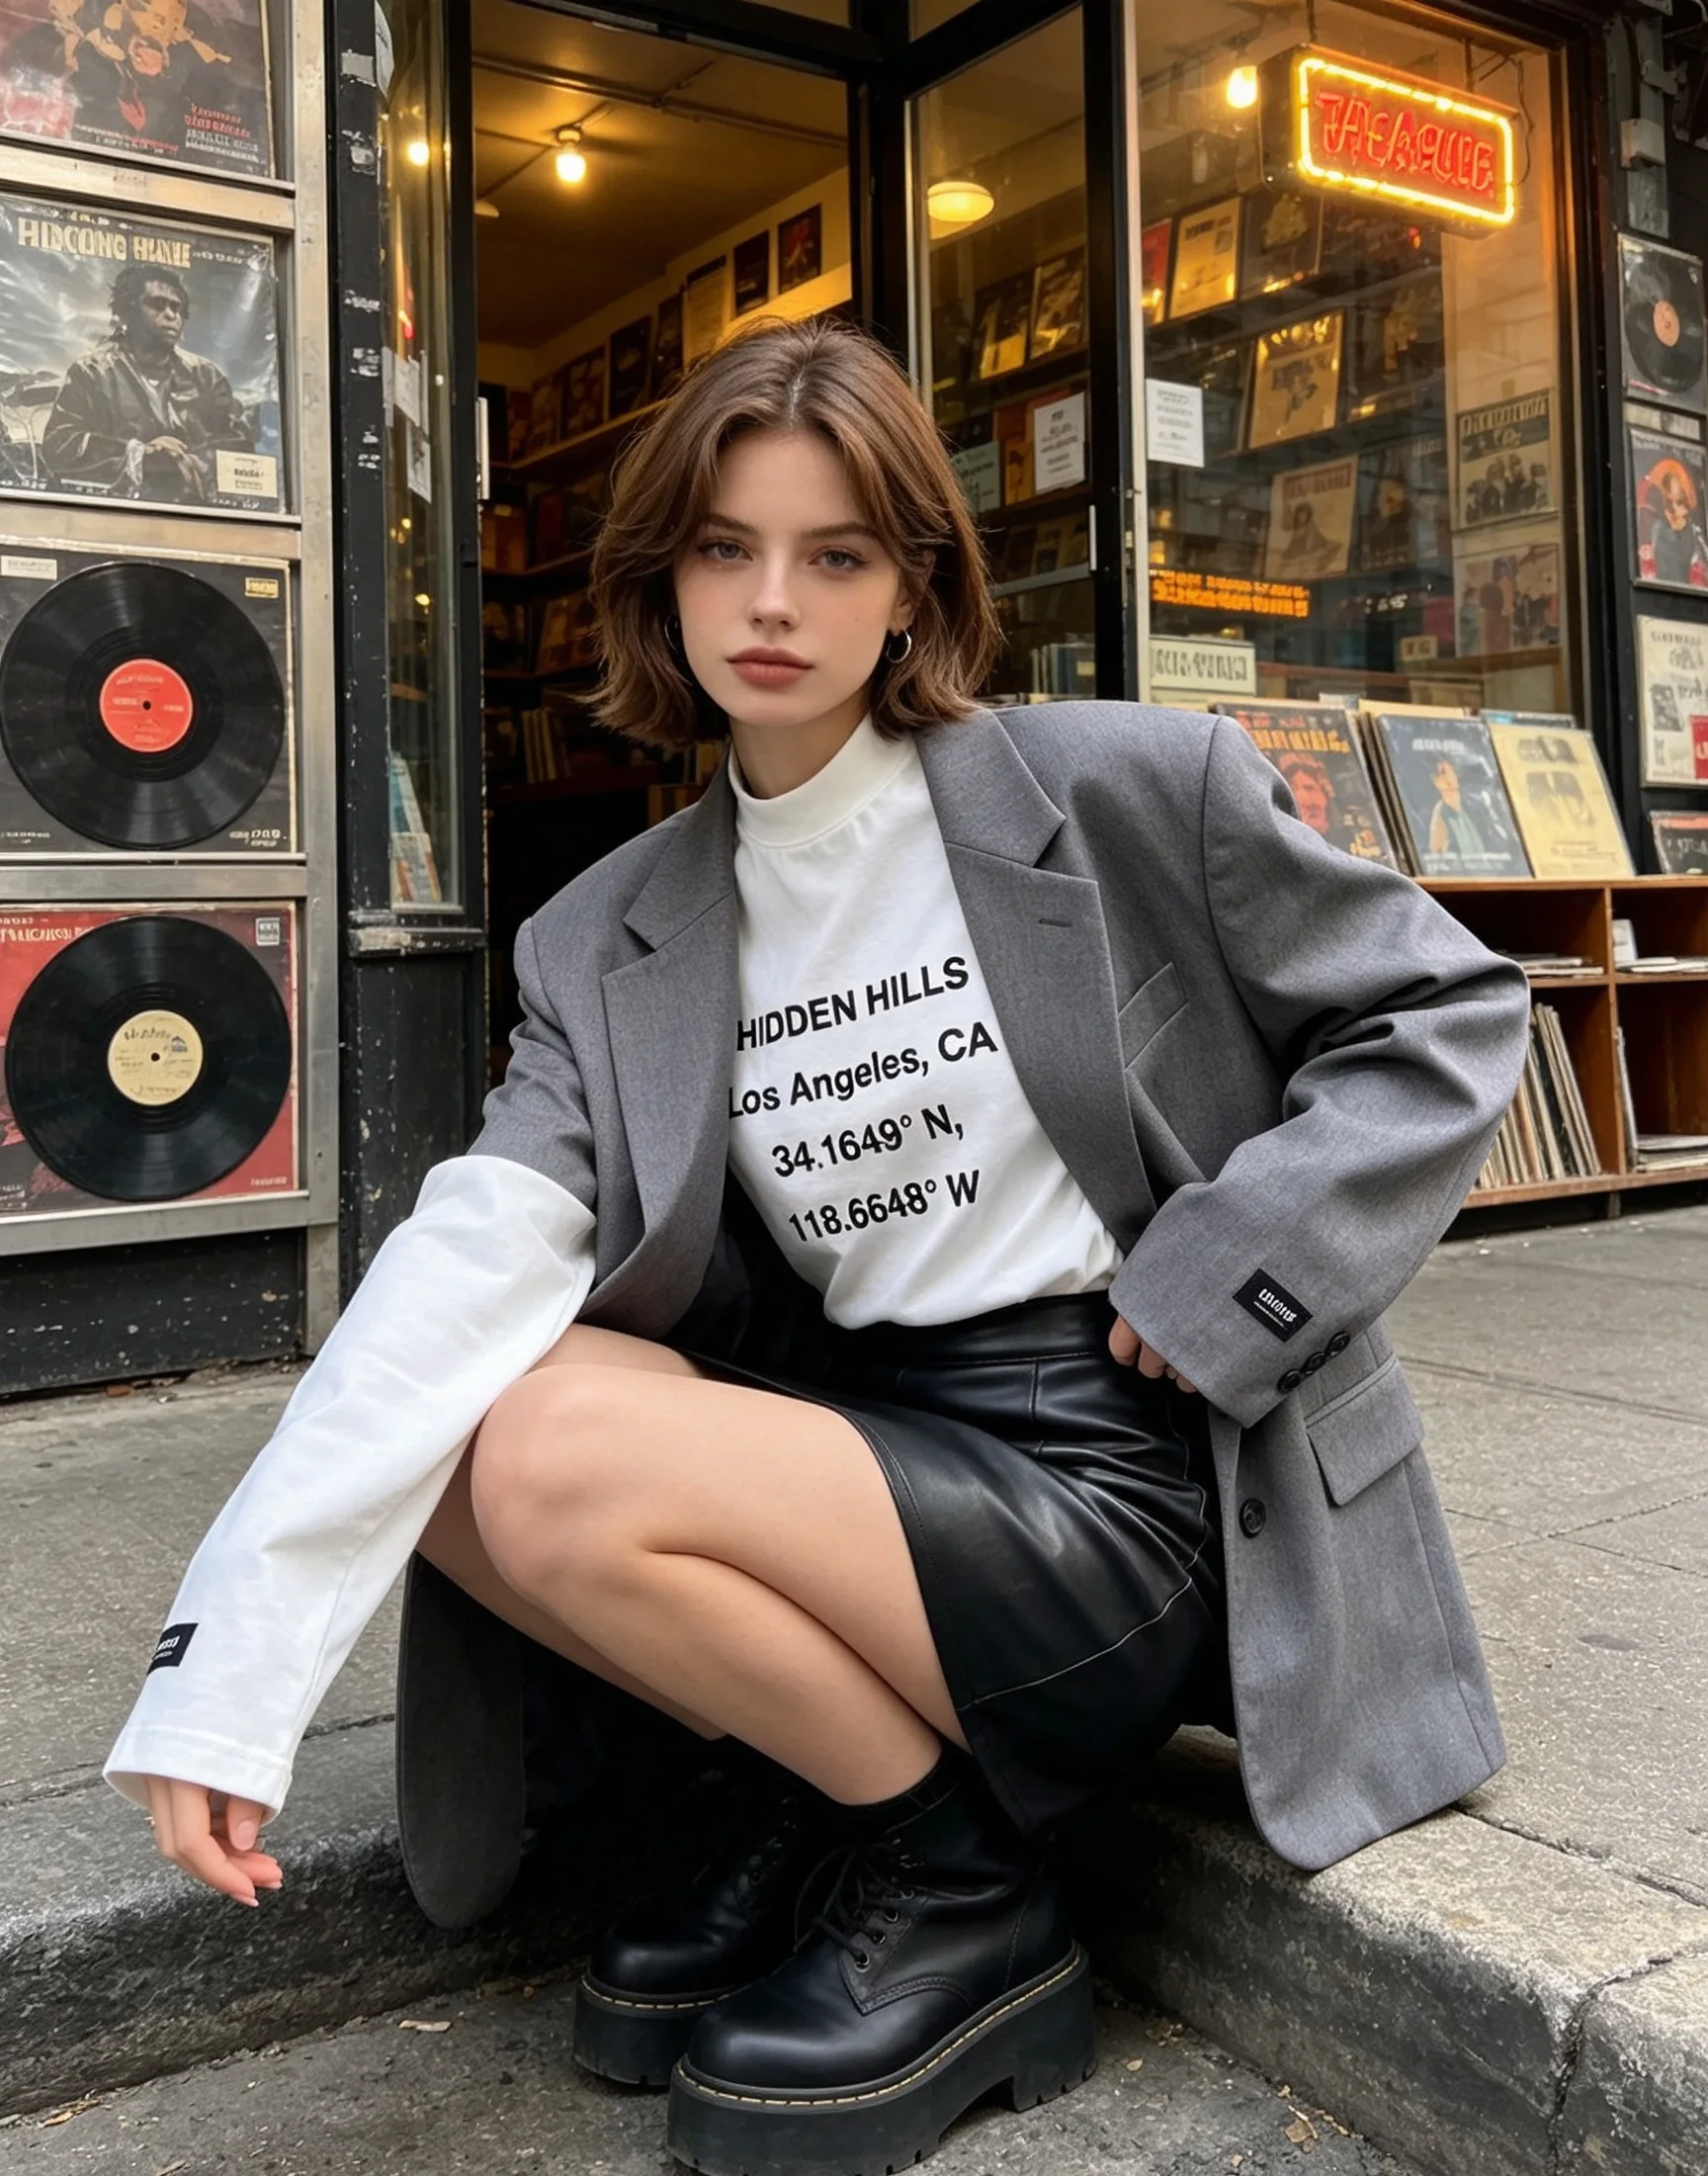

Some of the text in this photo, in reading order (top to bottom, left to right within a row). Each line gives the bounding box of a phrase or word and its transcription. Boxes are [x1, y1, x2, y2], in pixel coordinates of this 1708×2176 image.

[736, 956, 969, 1051] HIDDEN HILLS
[728, 1021, 998, 1119] Los Angeles, CA
[772, 1103, 964, 1177] 34.1649° N,
[789, 1170, 980, 1243] 118.6648° W
